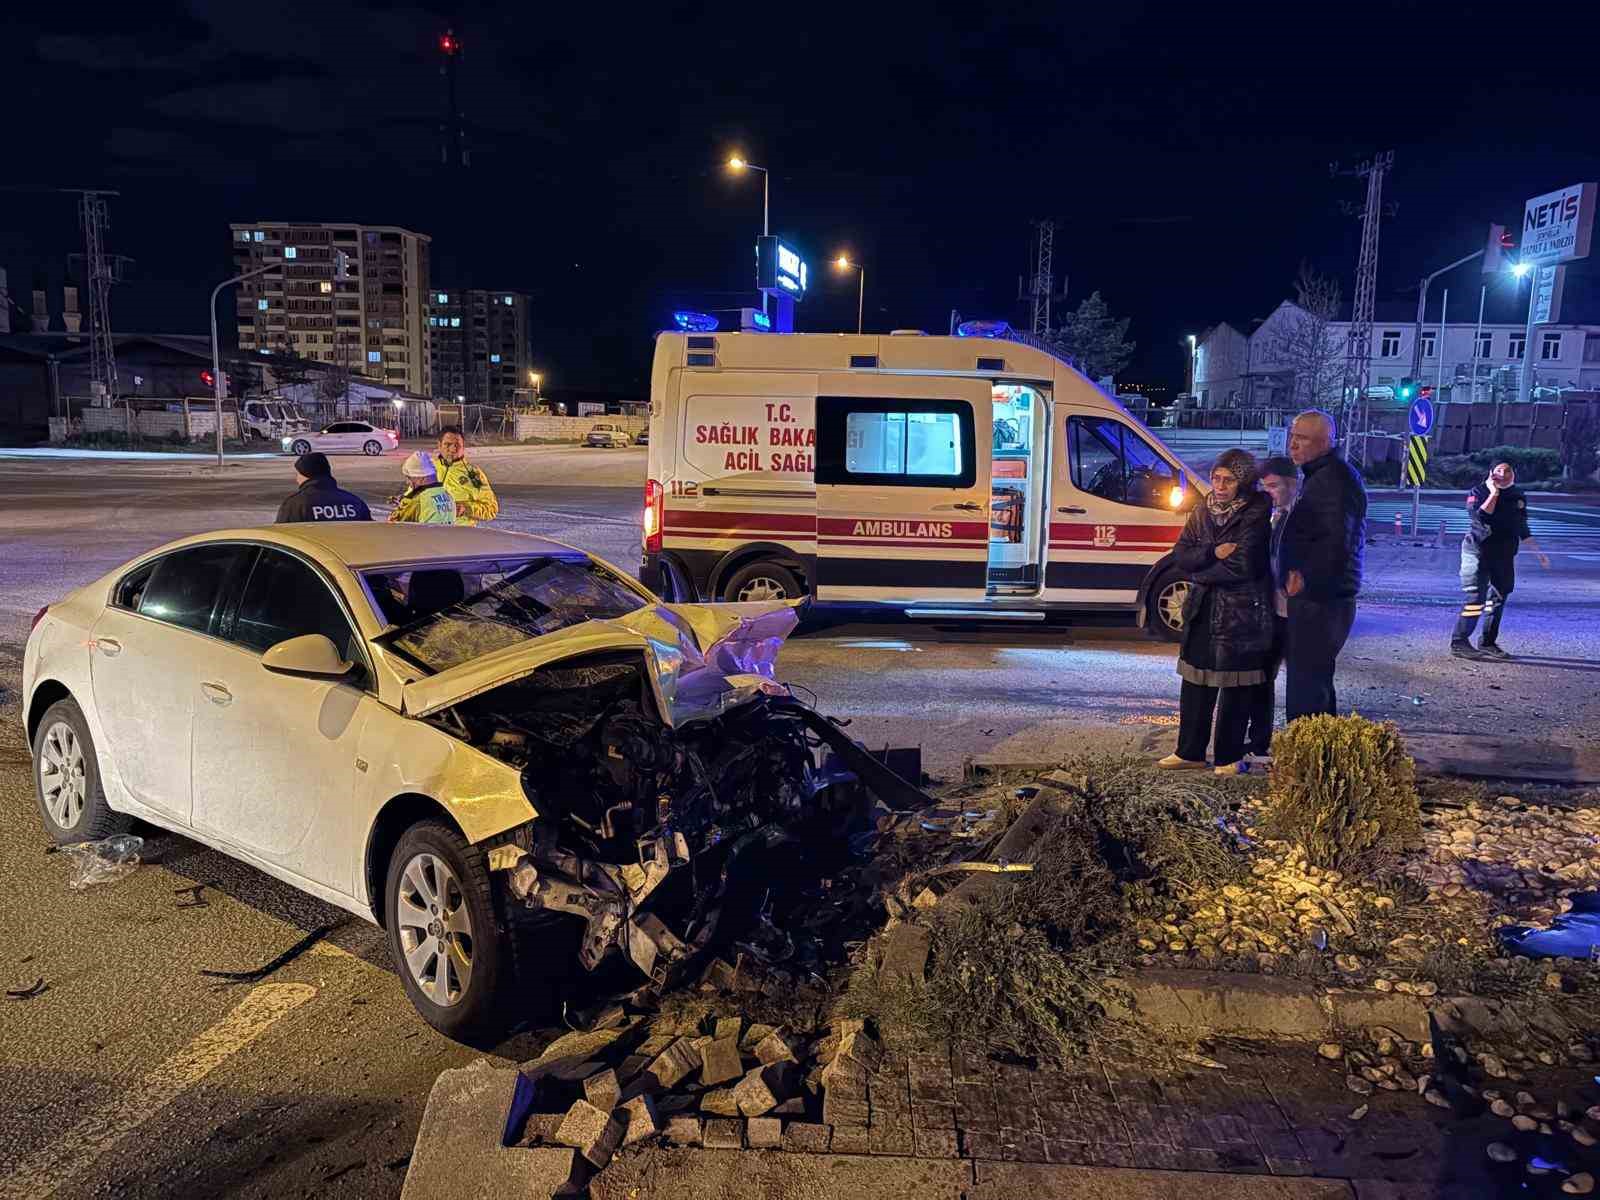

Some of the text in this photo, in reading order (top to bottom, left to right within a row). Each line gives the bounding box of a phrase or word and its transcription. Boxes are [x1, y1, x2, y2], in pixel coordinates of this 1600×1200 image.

[765, 403, 796, 423] T.C.
[696, 421, 759, 445] SAĞLIK
[769, 427, 816, 447] BAKA
[724, 448, 815, 472] ACİL SAĞL
[671, 480, 698, 496] 112
[312, 504, 356, 520] POLİS
[853, 521, 953, 538] AMBULANS
[1094, 525, 1116, 538] 112
